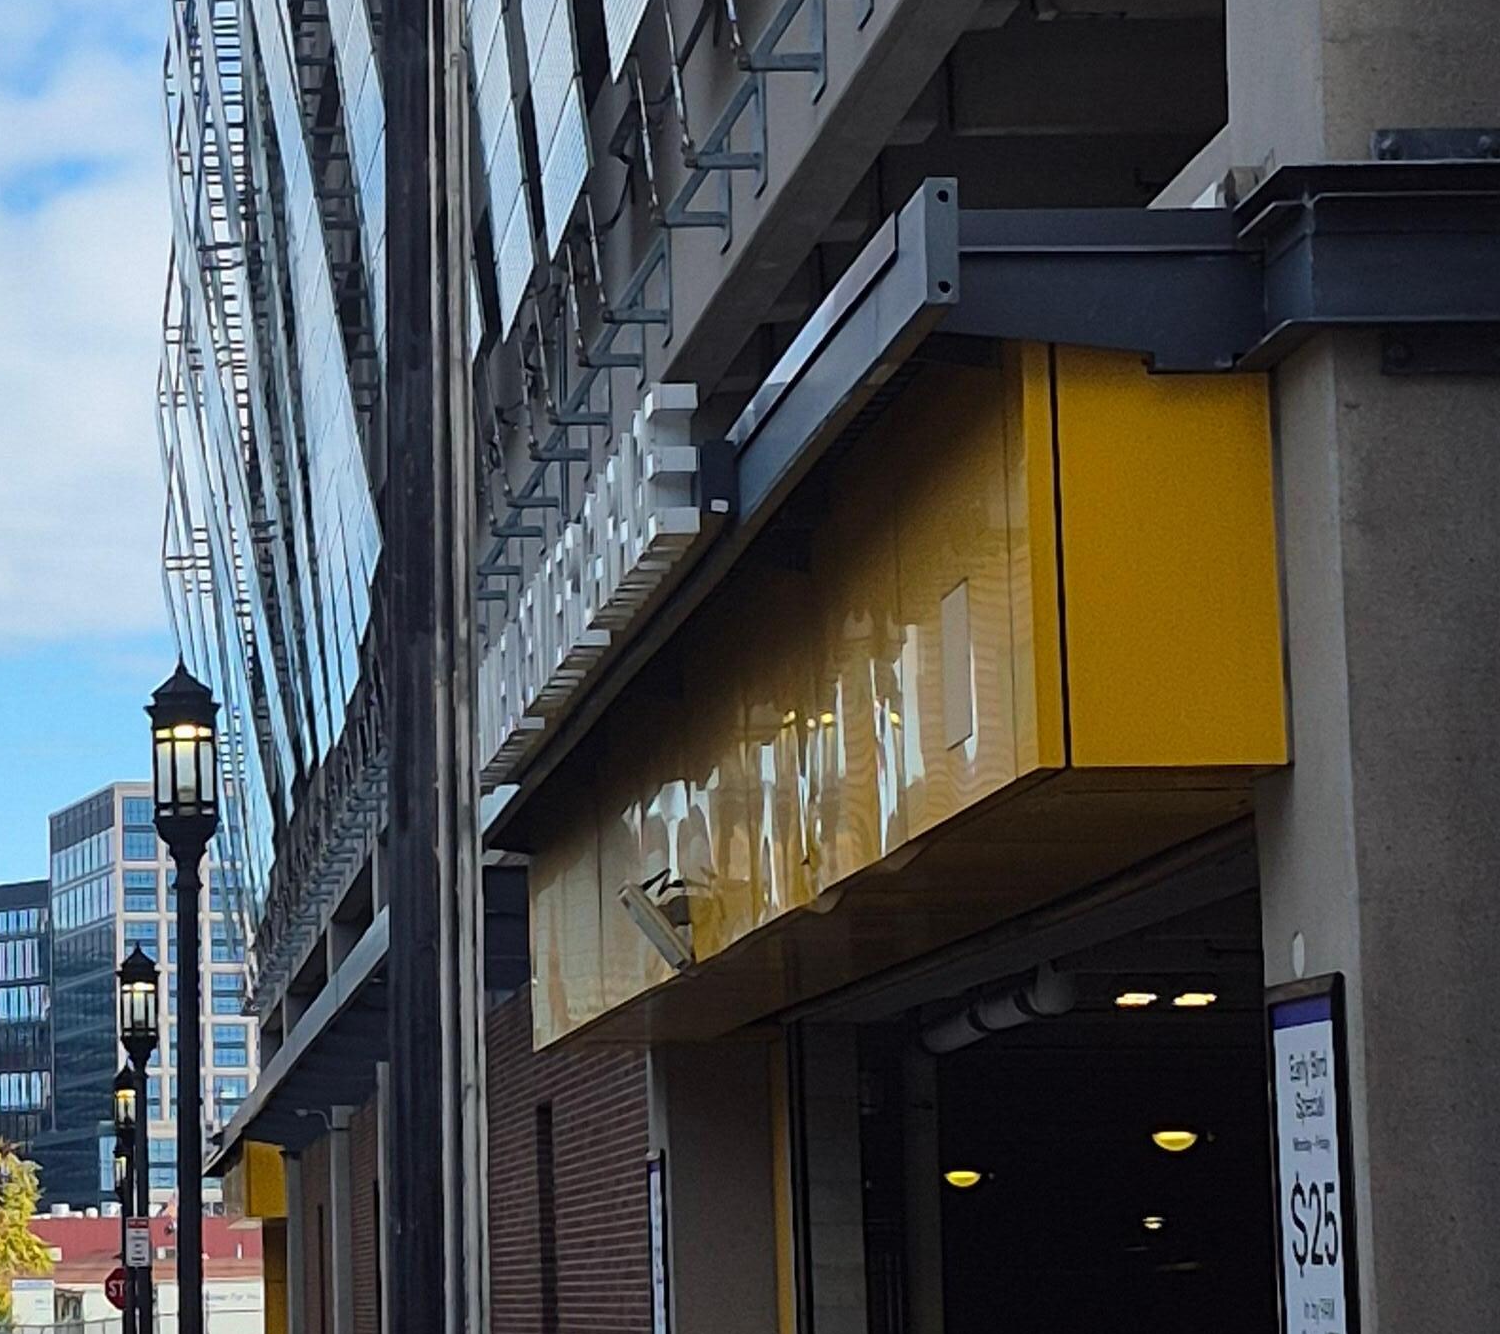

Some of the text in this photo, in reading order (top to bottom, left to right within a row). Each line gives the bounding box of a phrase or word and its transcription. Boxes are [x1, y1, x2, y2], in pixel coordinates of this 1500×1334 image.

[1289, 1050, 1327, 1087] Early Bird
[1296, 1090, 1325, 1126] Special
[1290, 1171, 1338, 1278] $25
[108, 1280, 125, 1297] ST
